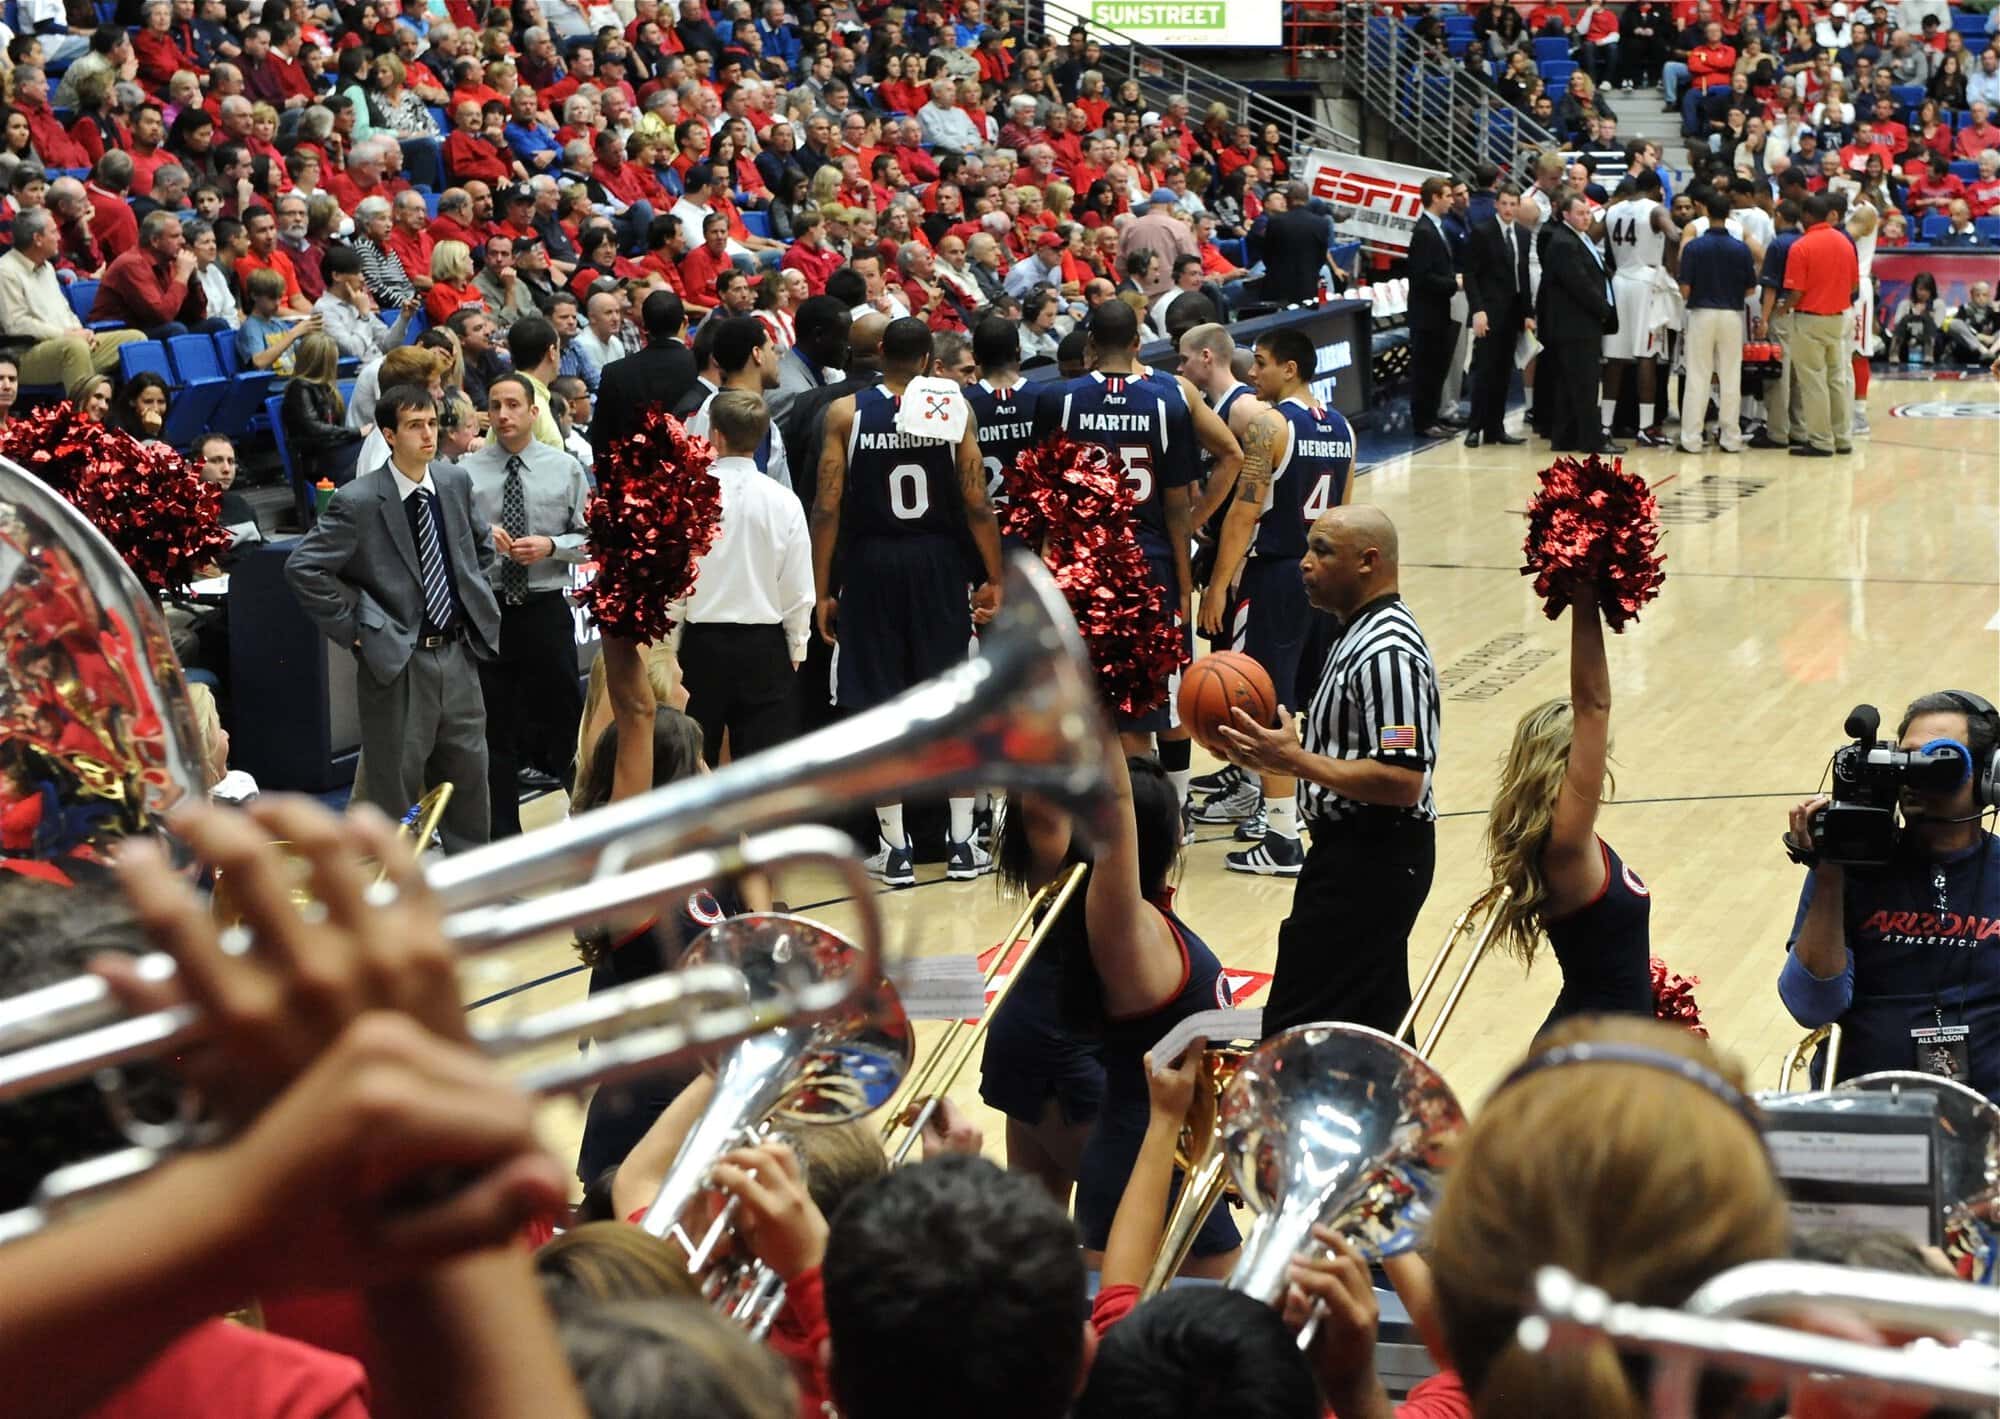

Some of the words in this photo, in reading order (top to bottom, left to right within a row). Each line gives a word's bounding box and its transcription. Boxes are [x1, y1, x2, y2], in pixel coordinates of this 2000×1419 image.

[1096, 5, 1220, 24] SUNSTREET
[1311, 166, 1424, 217] ESPN
[1612, 217, 1638, 247] 44
[1079, 413, 1150, 431] MARTIN
[1298, 439, 1351, 458] HERRERA
[889, 464, 929, 519] 0
[1303, 474, 1331, 520] 4
[1862, 909, 2000, 940] ARIZONA
